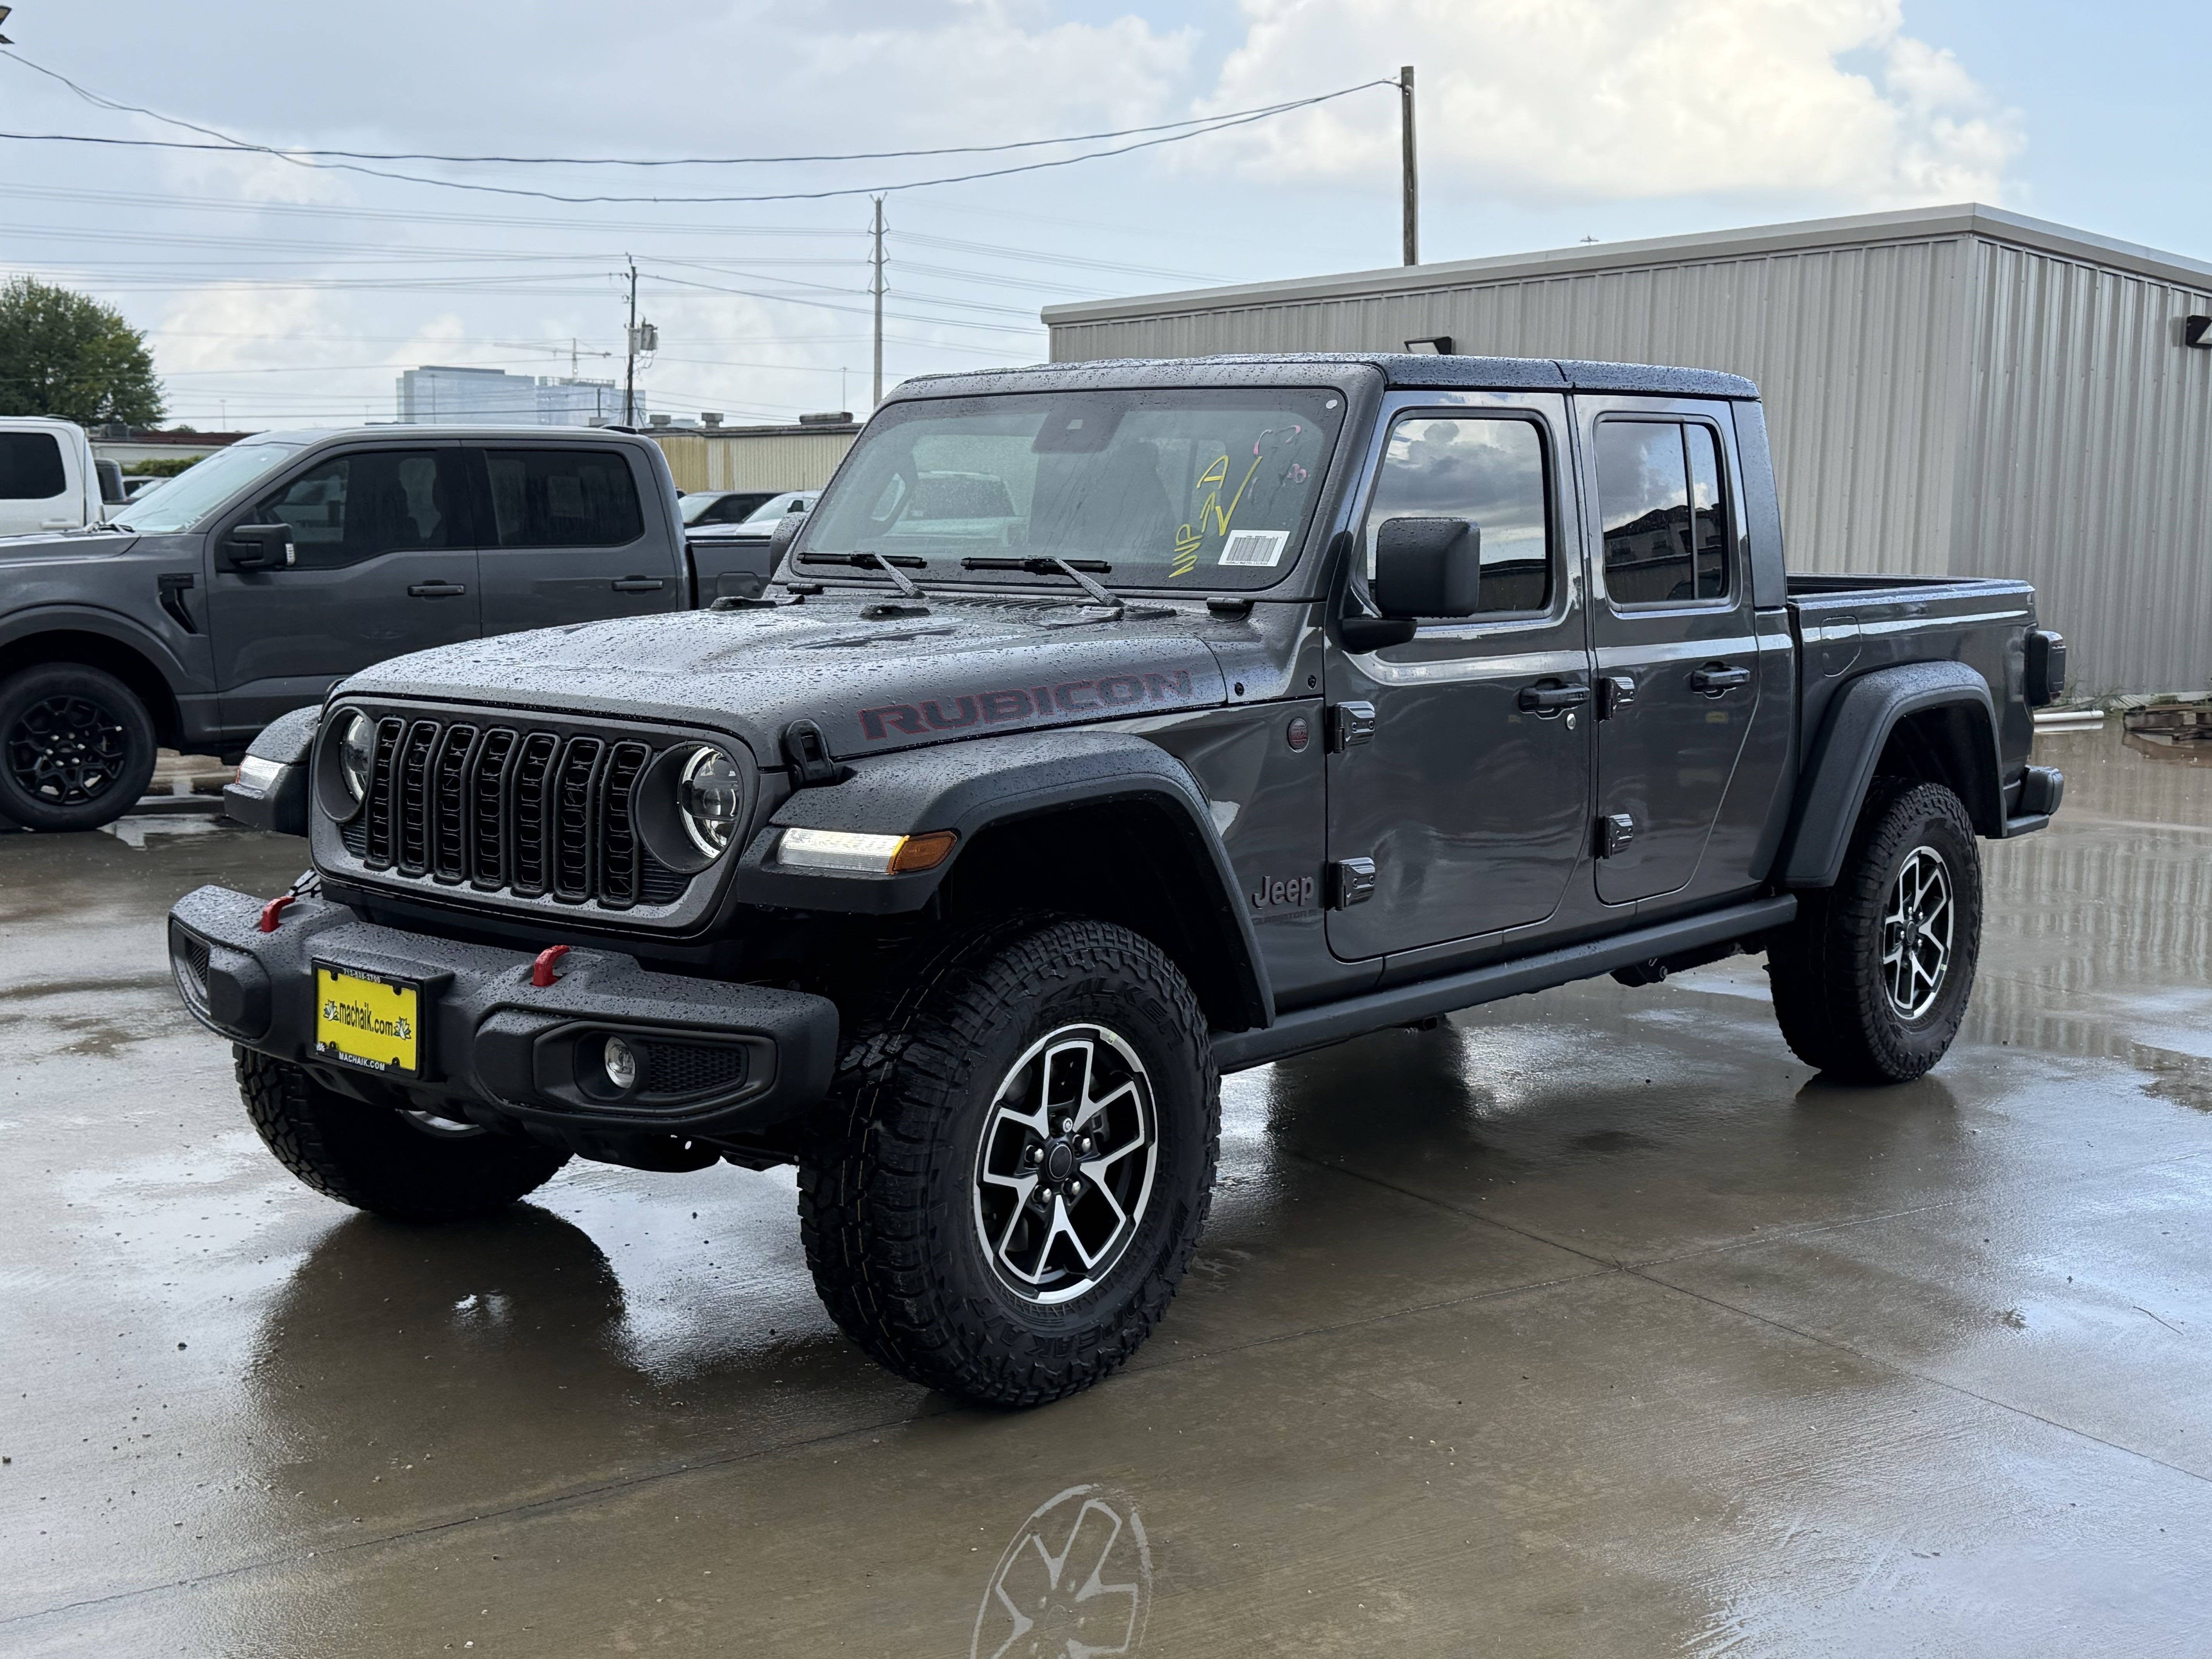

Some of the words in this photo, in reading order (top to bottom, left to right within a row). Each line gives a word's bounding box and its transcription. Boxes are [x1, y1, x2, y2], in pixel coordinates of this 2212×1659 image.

[857, 670, 1195, 740] RUBICON
[1251, 874, 1315, 909] Jeep
[339, 1000, 393, 1037] machaik.com
[338, 1052, 385, 1071] MACHAIK.COM
